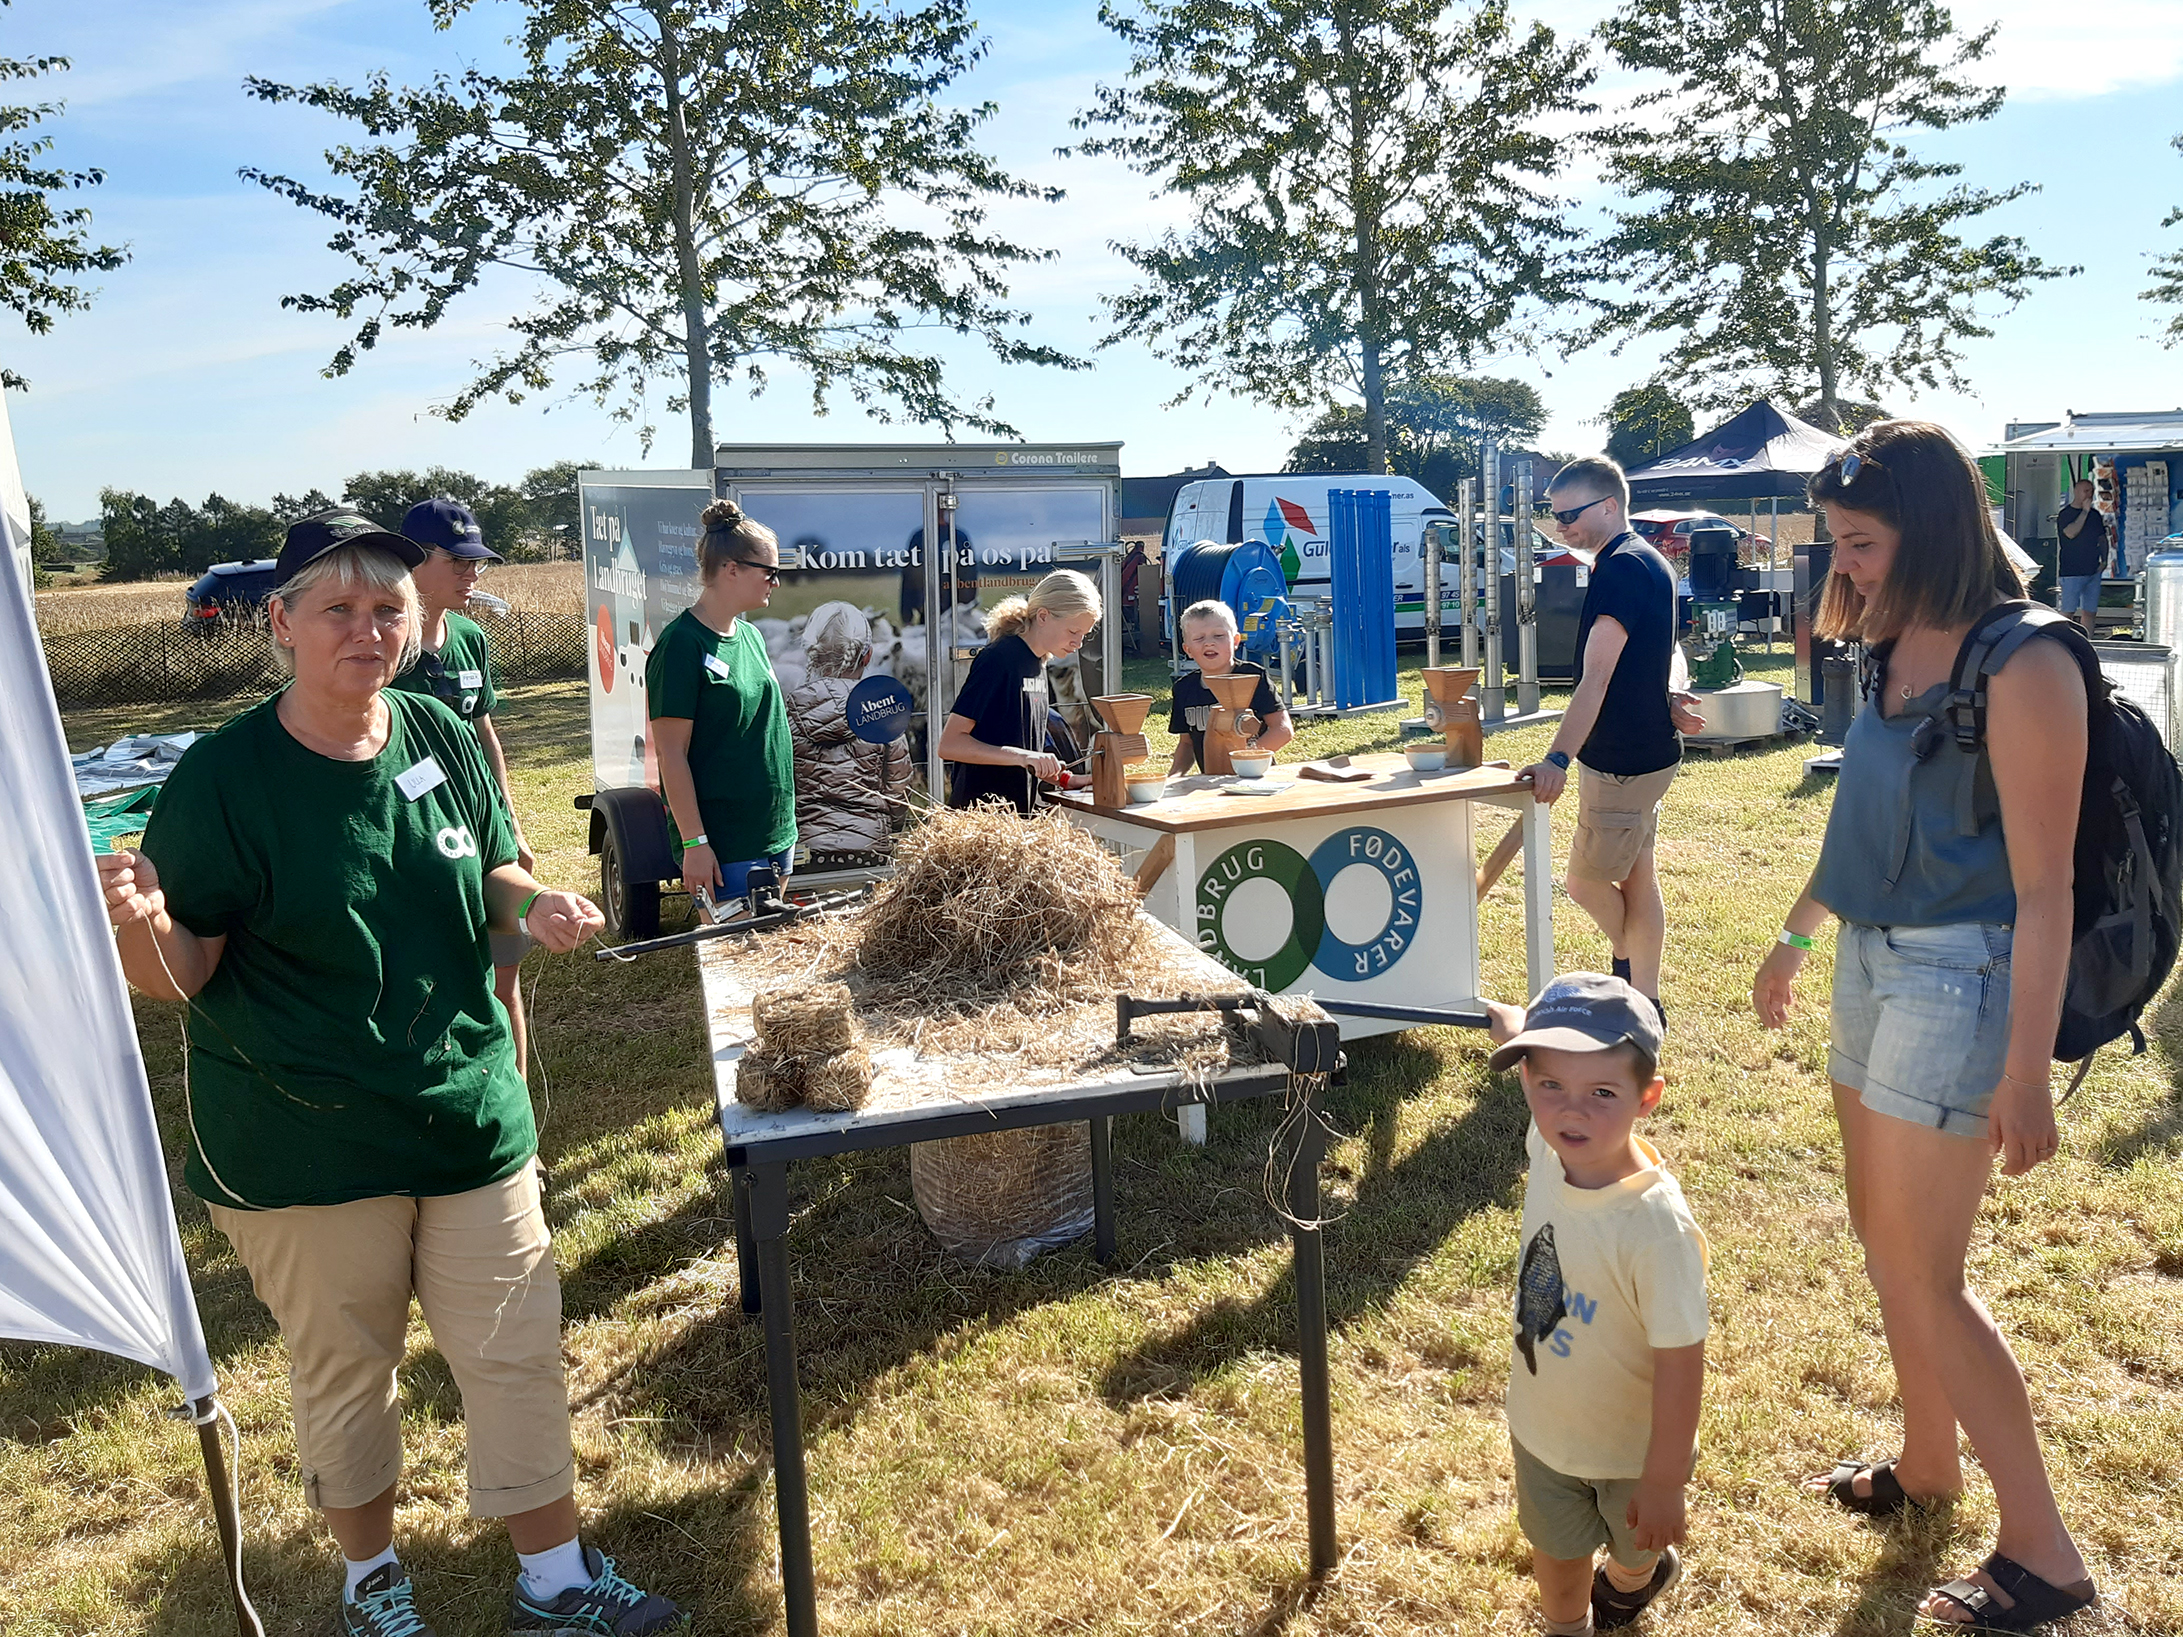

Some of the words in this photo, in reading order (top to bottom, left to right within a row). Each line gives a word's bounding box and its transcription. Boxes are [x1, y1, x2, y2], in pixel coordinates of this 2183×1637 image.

[1011, 452, 1053, 465] Corona
[1055, 452, 1098, 464] Trailere
[590, 505, 608, 541] Tæt
[608, 505, 621, 552] på
[797, 544, 867, 571] Kom
[873, 544, 923, 569] tæt
[981, 549, 1013, 566] os
[1303, 541, 1331, 557] Gul
[592, 555, 648, 609] Landbruget
[856, 702, 906, 727] LANDBRUG
[861, 694, 896, 715] Åbent
[1349, 834, 1417, 974] FØDEVARER
